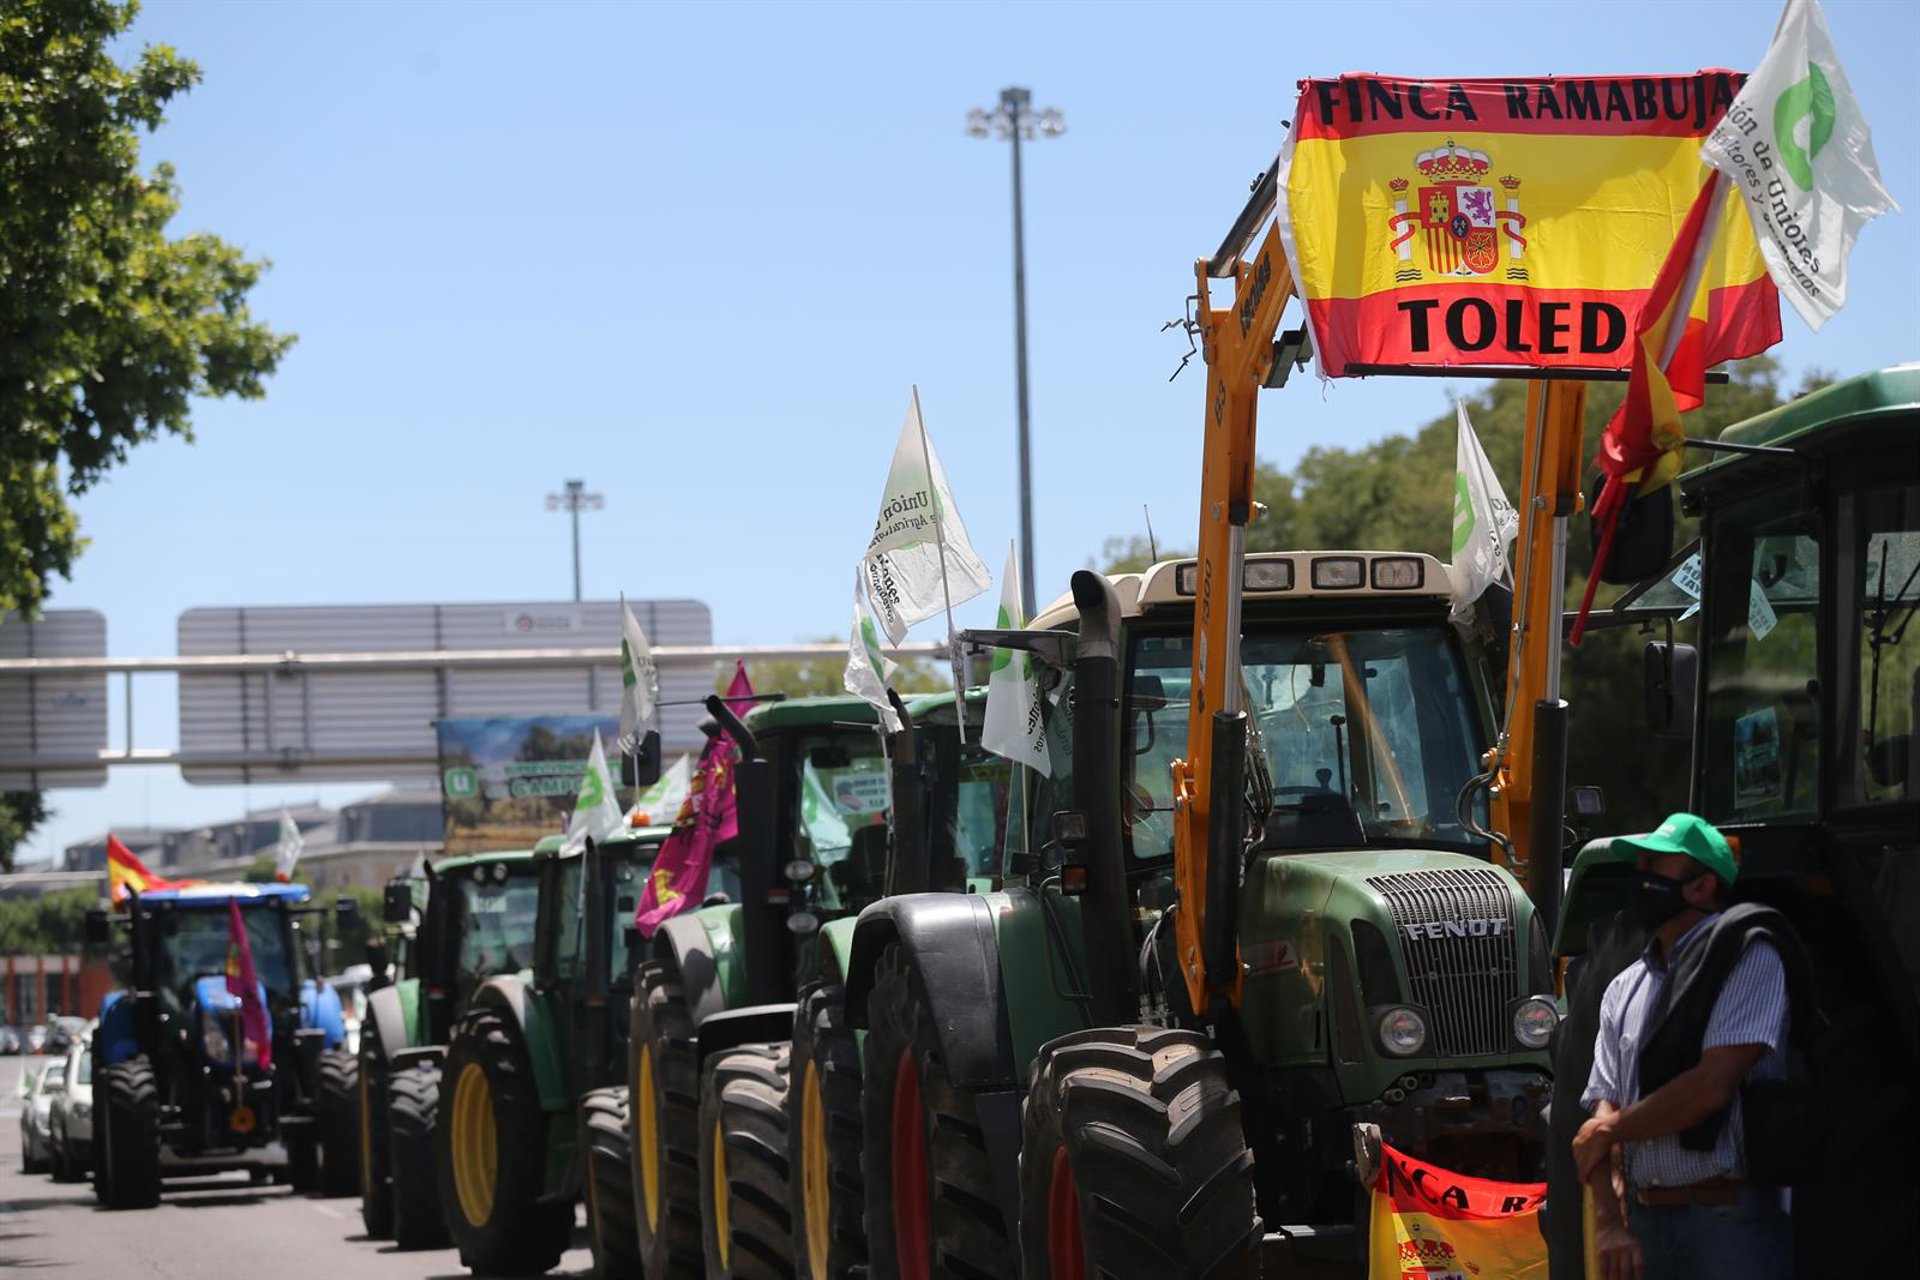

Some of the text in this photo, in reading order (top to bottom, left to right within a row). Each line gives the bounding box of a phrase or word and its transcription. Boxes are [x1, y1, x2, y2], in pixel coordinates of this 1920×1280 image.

[1319, 73, 1749, 129] FINCA RAMABUJA
[1727, 101, 1758, 137] ión
[1752, 140, 1773, 171] de
[1397, 296, 1627, 353] TOLED
[1404, 918, 1507, 940] FENDT
[1386, 1156, 1470, 1210] NCA
